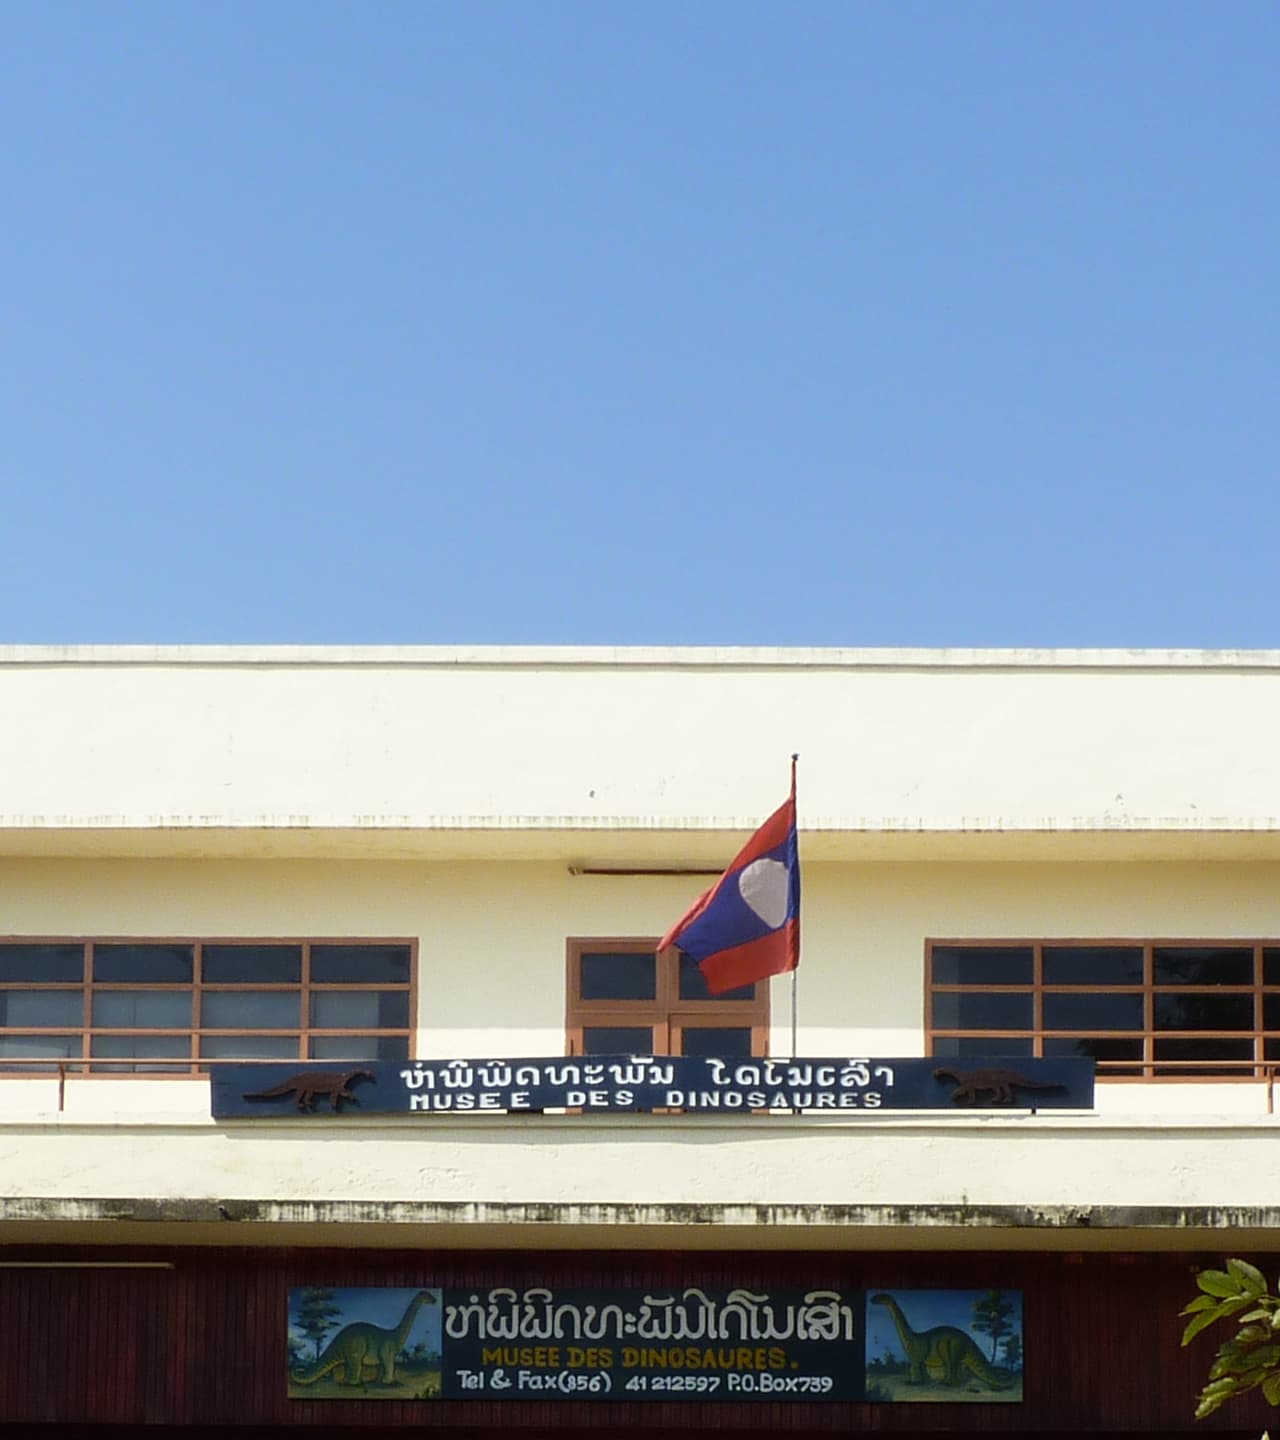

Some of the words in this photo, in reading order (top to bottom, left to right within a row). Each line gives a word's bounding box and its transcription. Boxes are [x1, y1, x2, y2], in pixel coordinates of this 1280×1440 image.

[408, 1091, 532, 1111] MUSEE
[566, 1090, 635, 1107] DES
[665, 1091, 883, 1108] DINOSAURES
[482, 1346, 560, 1367] MUSEE
[567, 1347, 613, 1368] DES
[455, 1370, 485, 1390] Tel
[489, 1368, 513, 1390] &
[624, 1375, 648, 1392] 41
[650, 1375, 721, 1393] 212597
